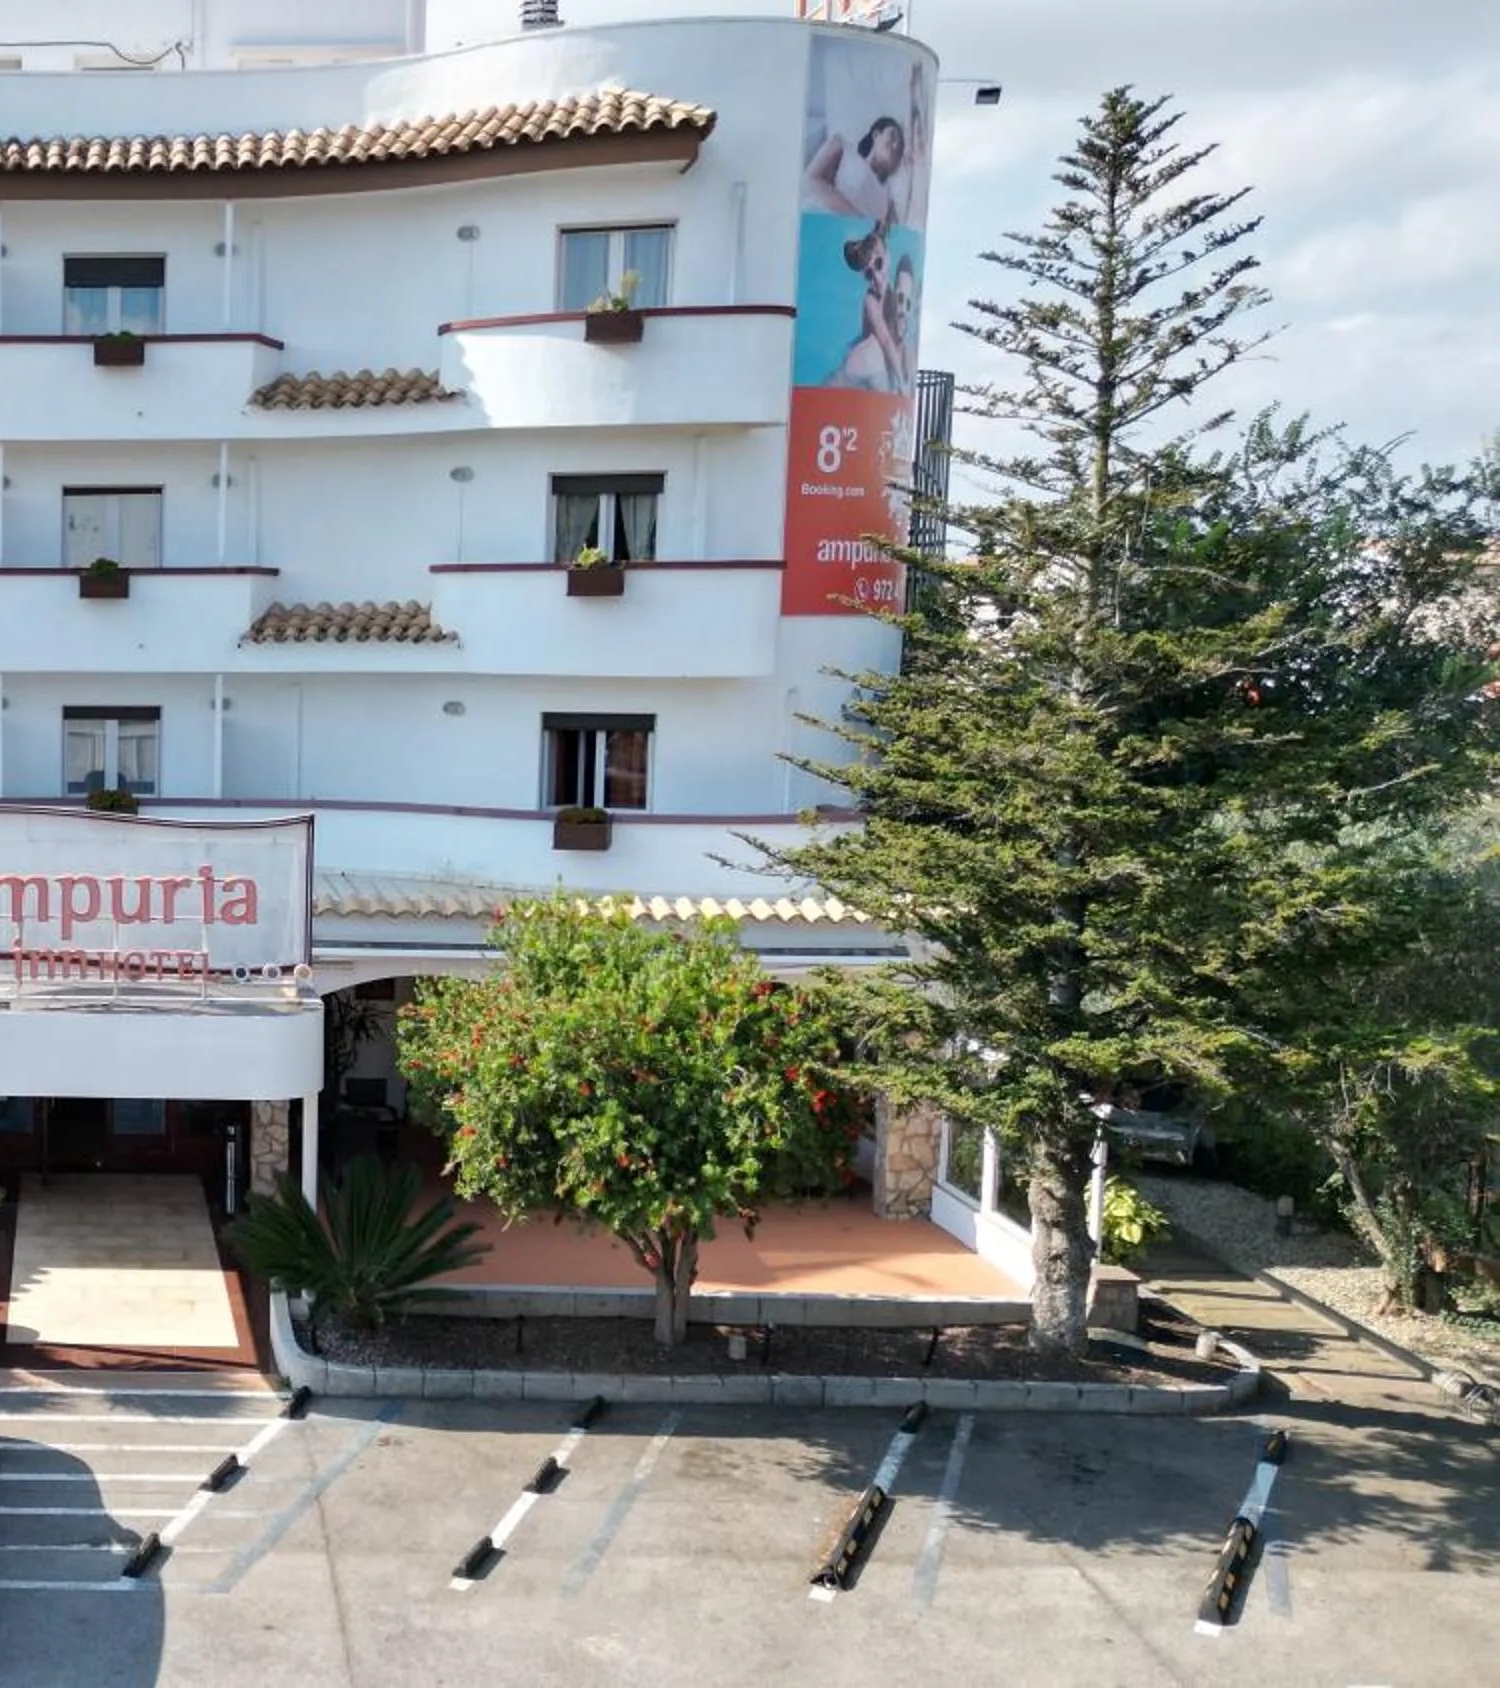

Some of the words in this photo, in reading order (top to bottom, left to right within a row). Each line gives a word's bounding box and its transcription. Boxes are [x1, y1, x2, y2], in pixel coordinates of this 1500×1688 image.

[801, 483, 865, 498] Booking.com
[13, 938, 87, 983] inn
[100, 951, 220, 982] HOTEL
